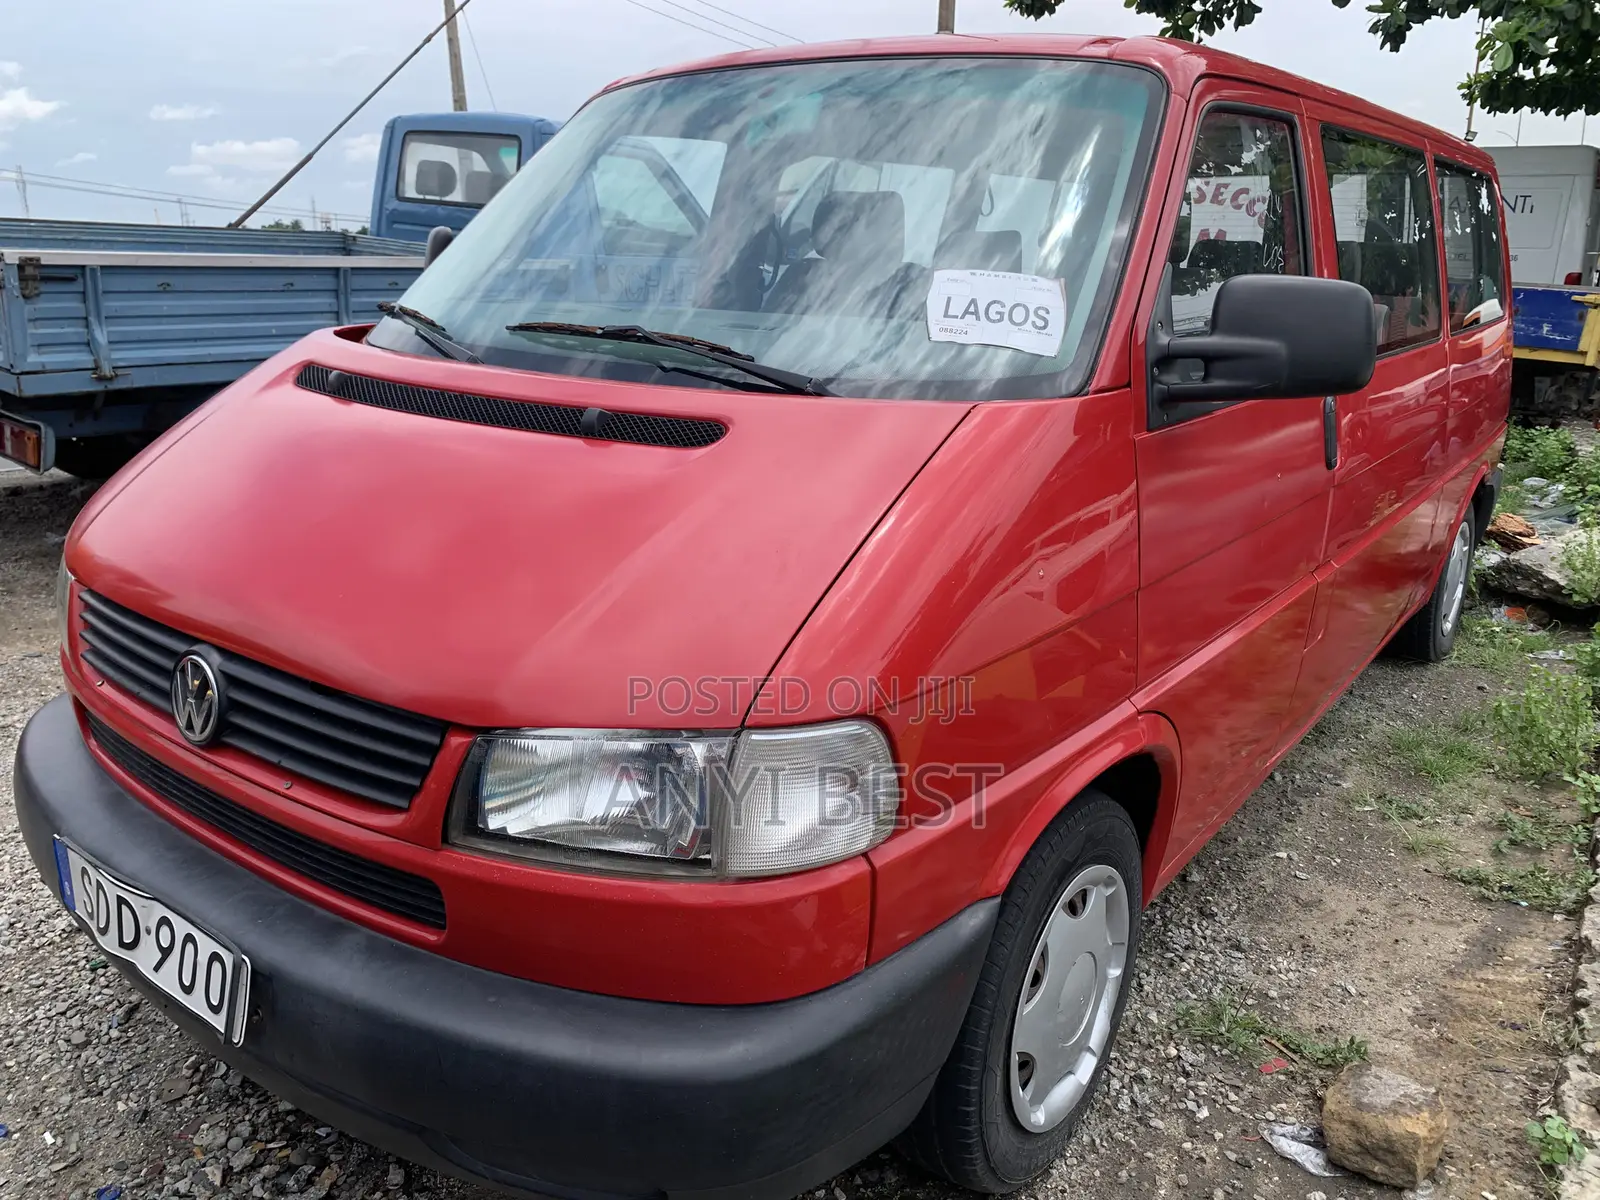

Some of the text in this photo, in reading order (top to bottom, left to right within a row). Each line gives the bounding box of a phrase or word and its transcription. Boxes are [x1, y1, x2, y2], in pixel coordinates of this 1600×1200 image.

[938, 326, 968, 336] 088224
[942, 296, 1051, 331] LAGOS
[80, 865, 227, 1016] SDD 900
